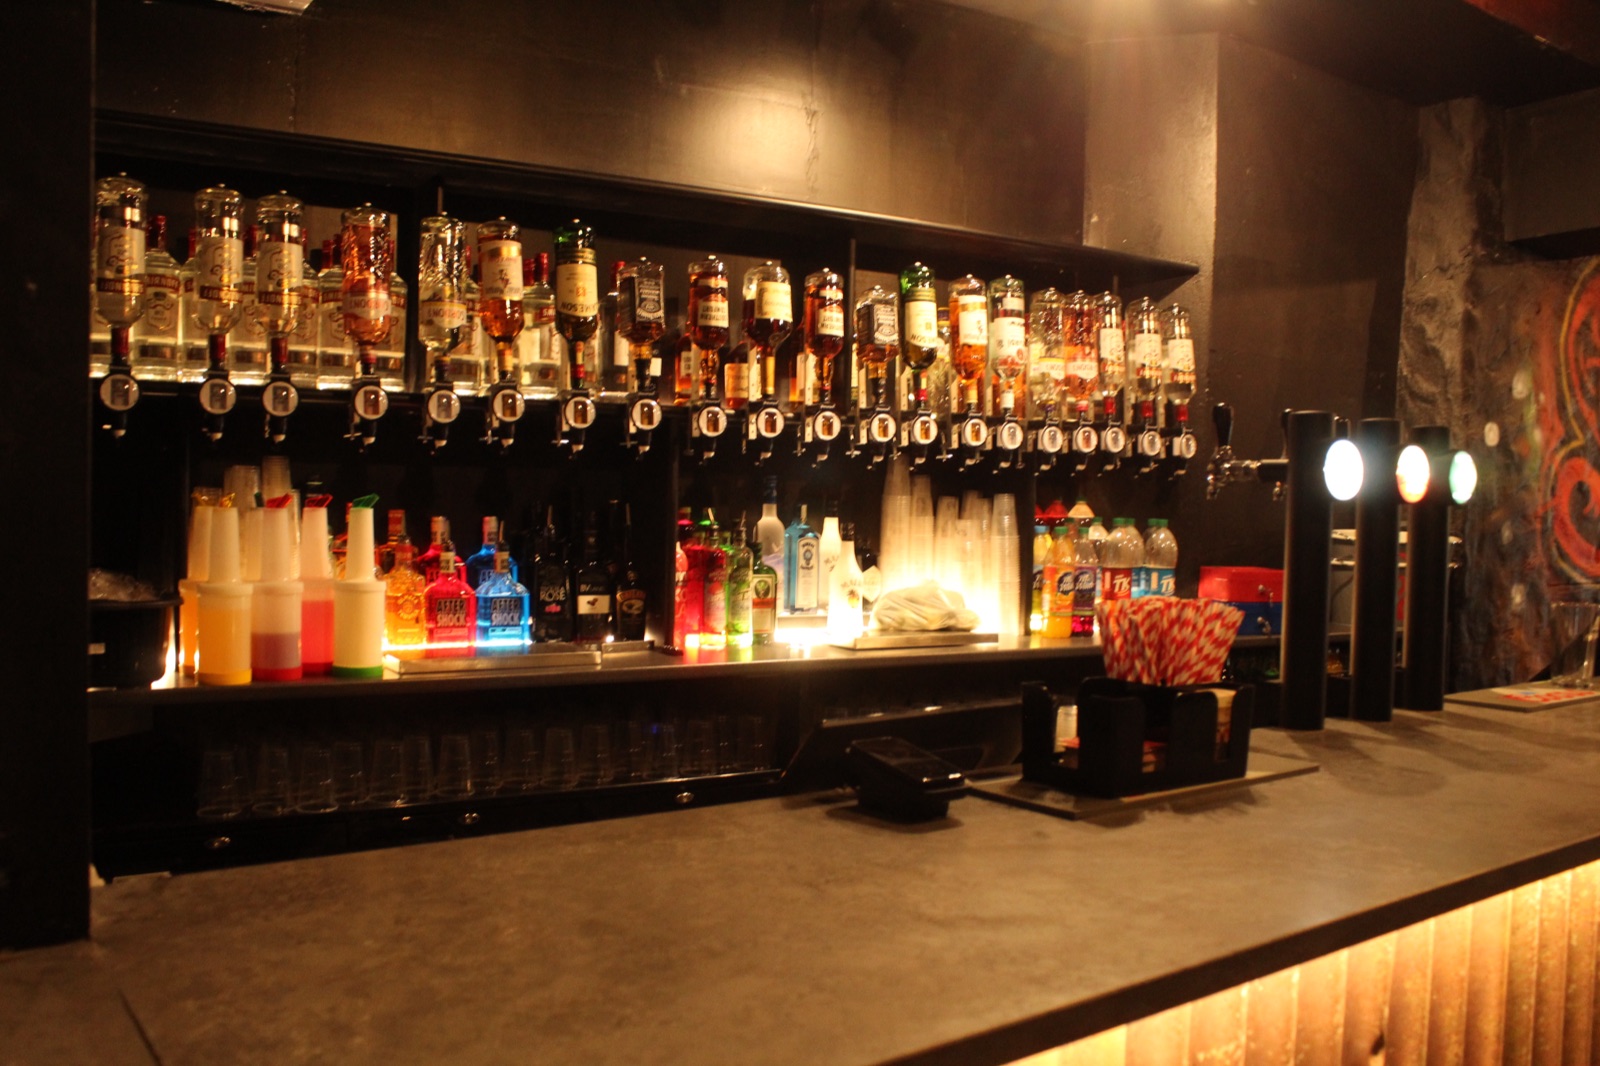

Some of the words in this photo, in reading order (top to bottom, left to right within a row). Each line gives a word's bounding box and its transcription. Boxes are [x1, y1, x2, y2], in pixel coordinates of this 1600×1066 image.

[540, 589, 567, 602] ROSE
[436, 598, 467, 613] AFTER
[491, 598, 521, 613] AFTER
[436, 612, 467, 627] SHOCK
[491, 612, 521, 627] SHOCK
